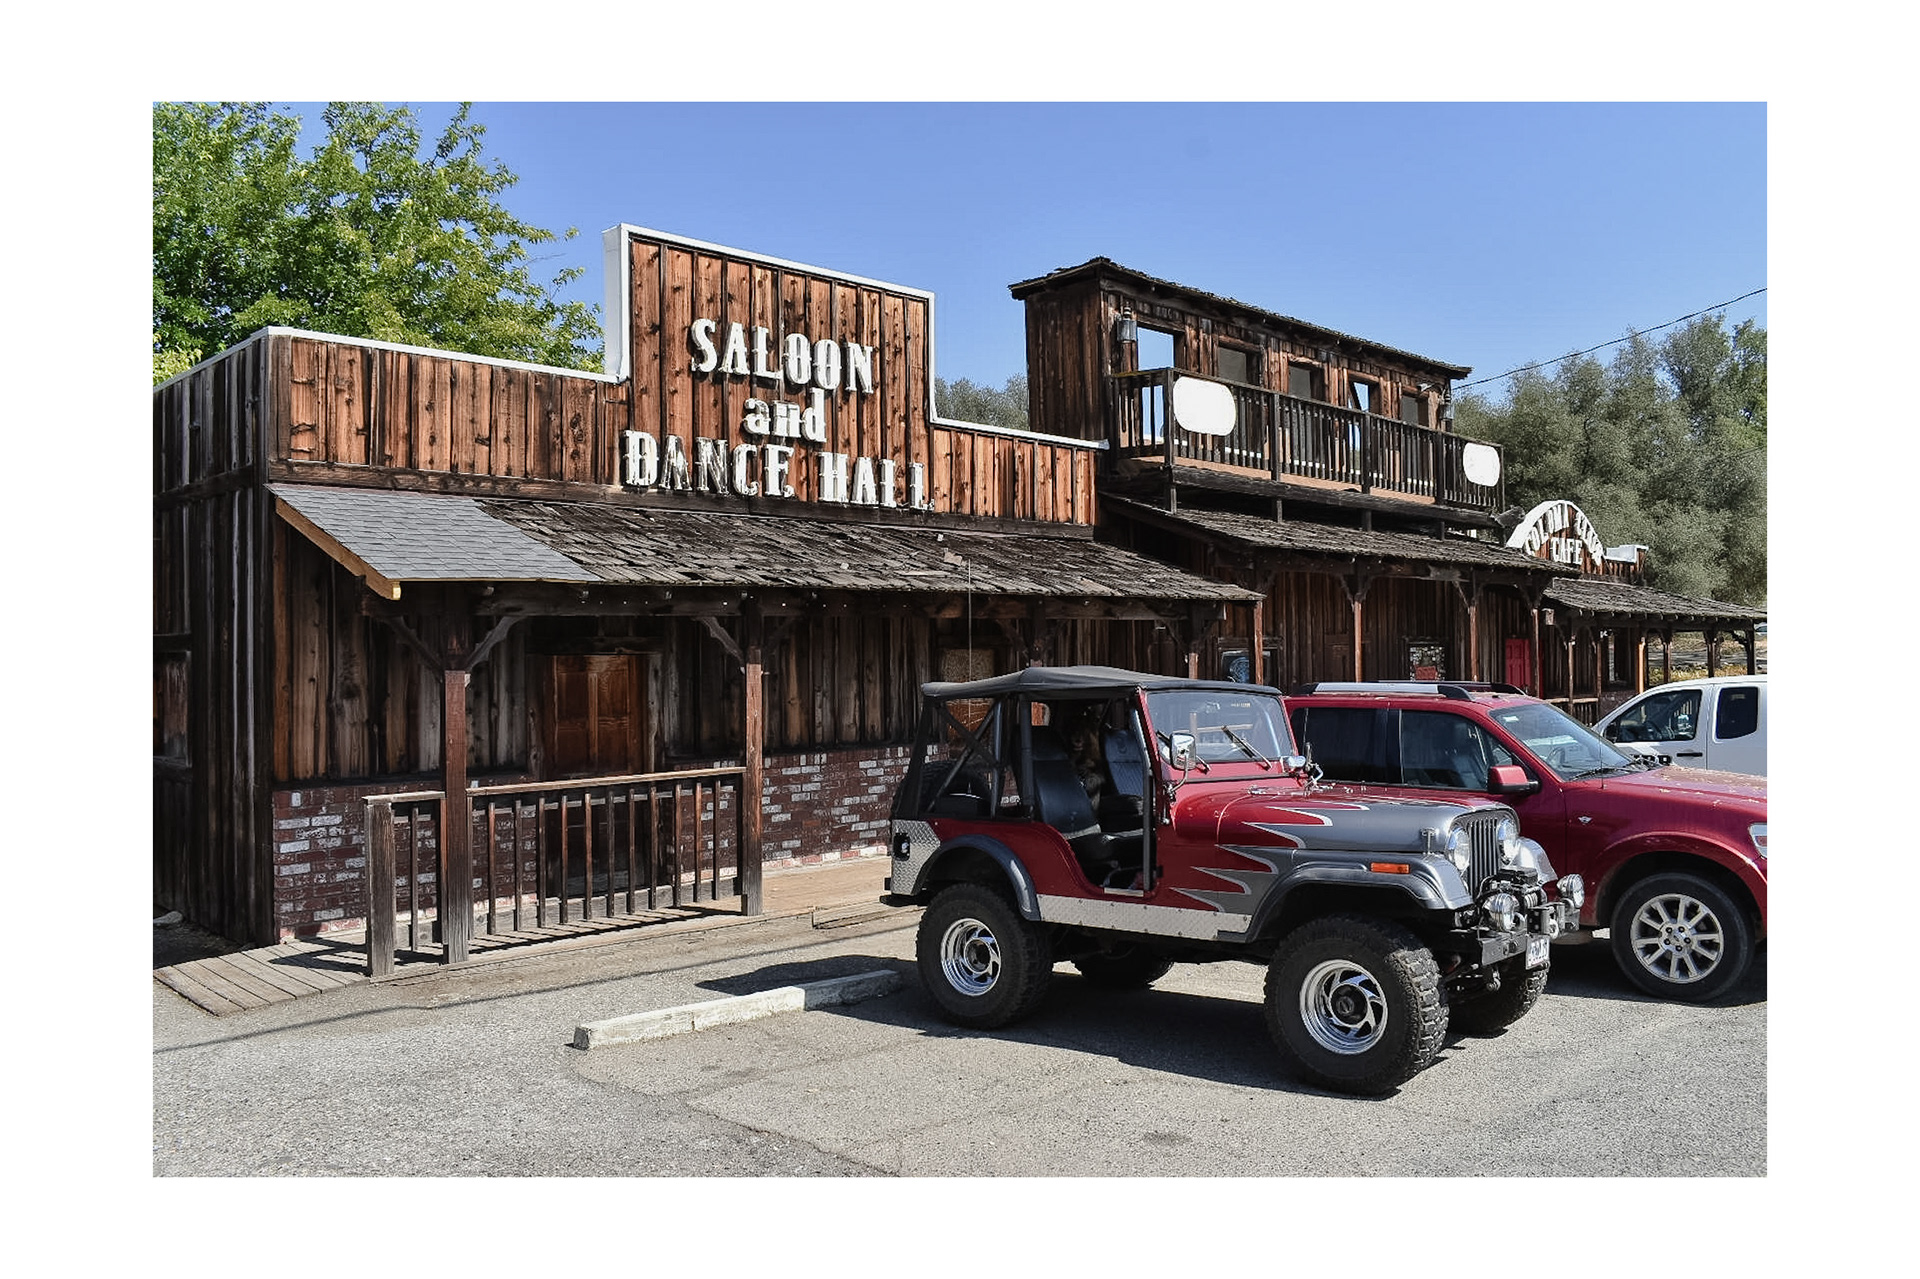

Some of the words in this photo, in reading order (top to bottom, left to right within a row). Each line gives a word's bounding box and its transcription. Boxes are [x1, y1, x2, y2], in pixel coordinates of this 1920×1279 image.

[691, 318, 874, 394] SALOON
[742, 387, 827, 443] and
[622, 430, 795, 498] DANCE
[818, 451, 935, 511] HALL
[1550, 537, 1583, 565] CAFE
